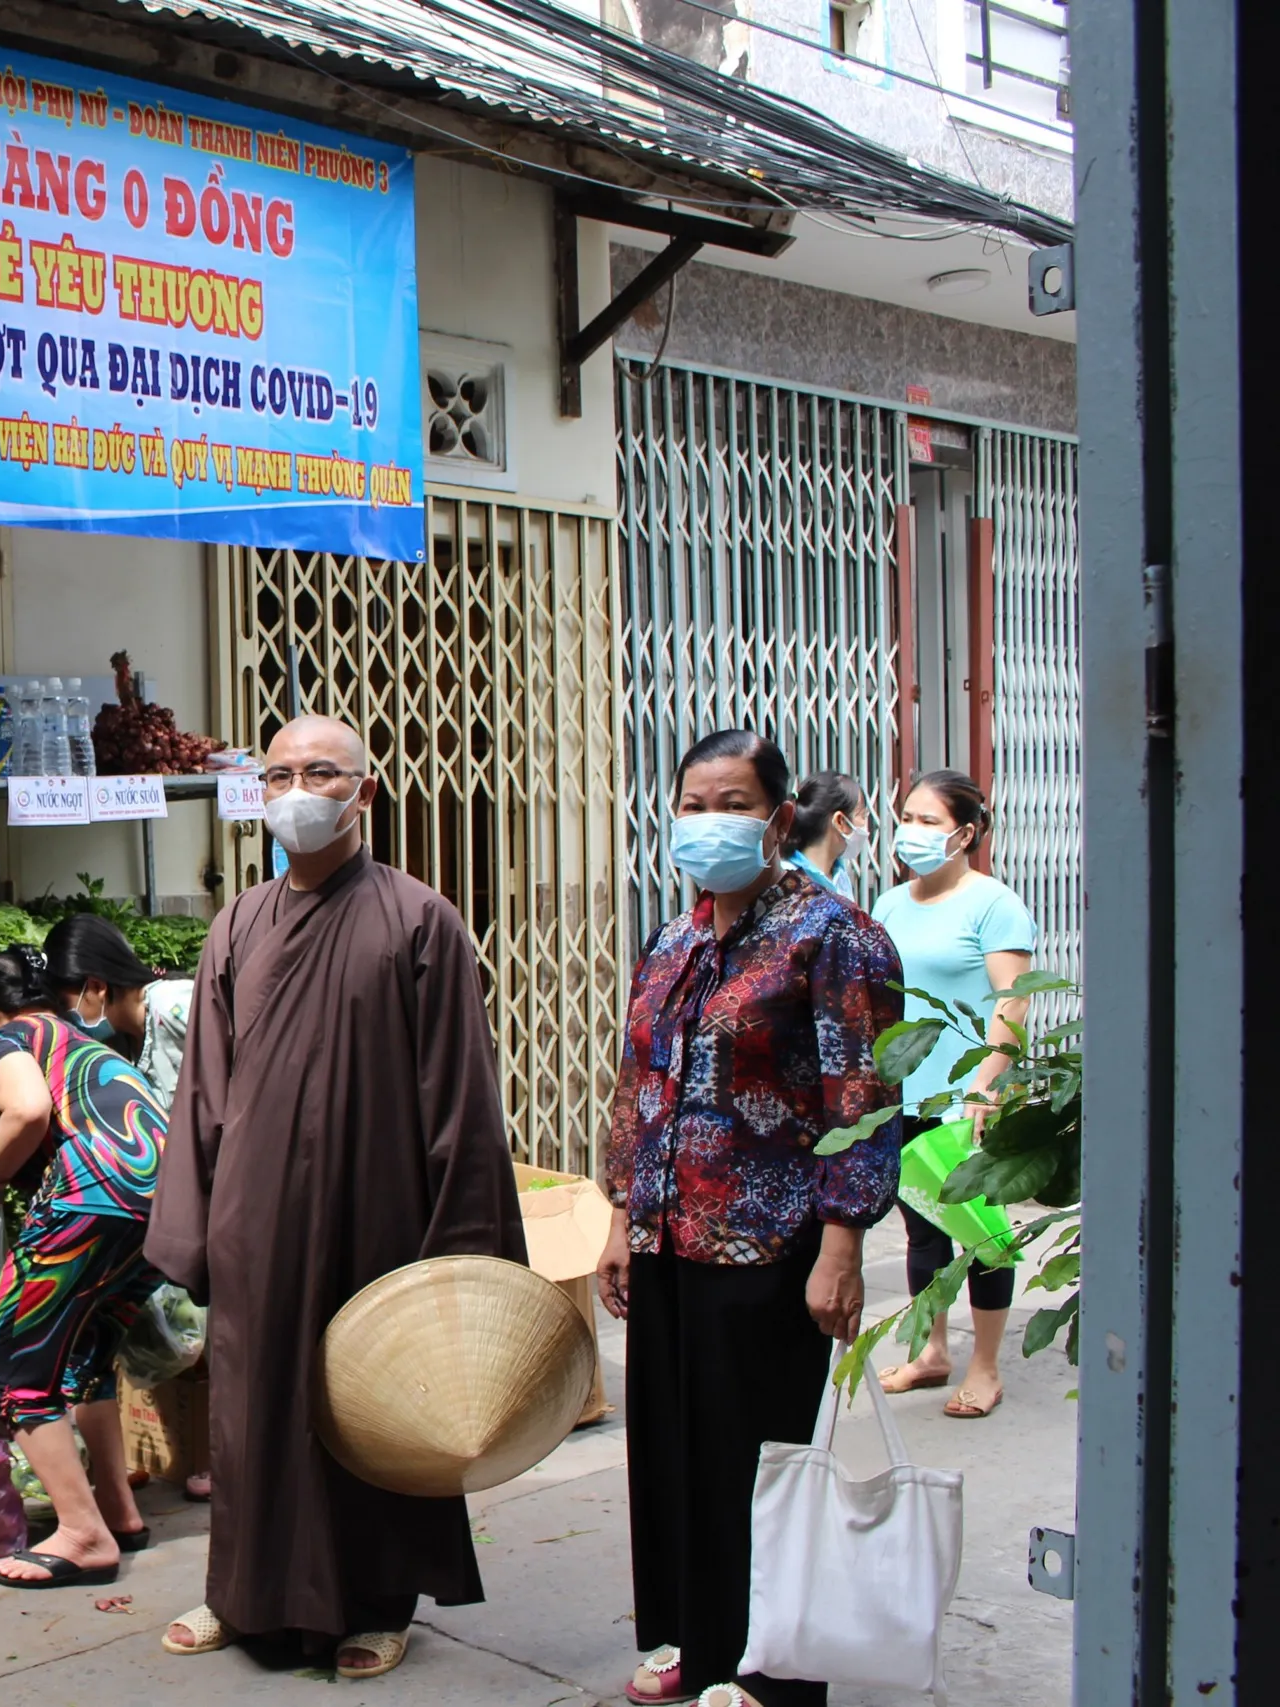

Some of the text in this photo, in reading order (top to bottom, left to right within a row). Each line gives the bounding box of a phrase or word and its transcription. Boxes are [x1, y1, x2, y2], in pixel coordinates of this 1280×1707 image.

[31, 78, 74, 130] PHỤ
[79, 87, 108, 129] NỮ
[128, 100, 184, 147] ĐOÀN
[187, 115, 253, 162] THANH
[256, 129, 300, 173] NIÊN
[303, 144, 375, 191] PHƯỜNG
[378, 161, 389, 194] 3
[123, 169, 149, 230] 0
[164, 163, 295, 257] ĐỒNG
[30, 233, 106, 315] YÊU
[113, 254, 264, 341] THƯƠNG
[37, 332, 99, 397] QUA
[108, 343, 161, 407] ĐẠI
[170, 351, 241, 415] DỊCH
[250, 364, 378, 429] COVID-19
[53, 415, 89, 469] HẢI
[93, 423, 135, 474] ĐỨC
[139, 427, 167, 477] VÀ
[171, 434, 208, 490] QUÝ
[211, 443, 233, 492] VỊ
[236, 446, 292, 496] MẠNH
[295, 450, 365, 500] THƯỜNG
[370, 460, 412, 510] QUÂN
[37, 789, 83, 811] NƯỚC NGỌT
[115, 786, 138, 805] NƯỚC
[242, 788, 259, 806] HẠT
